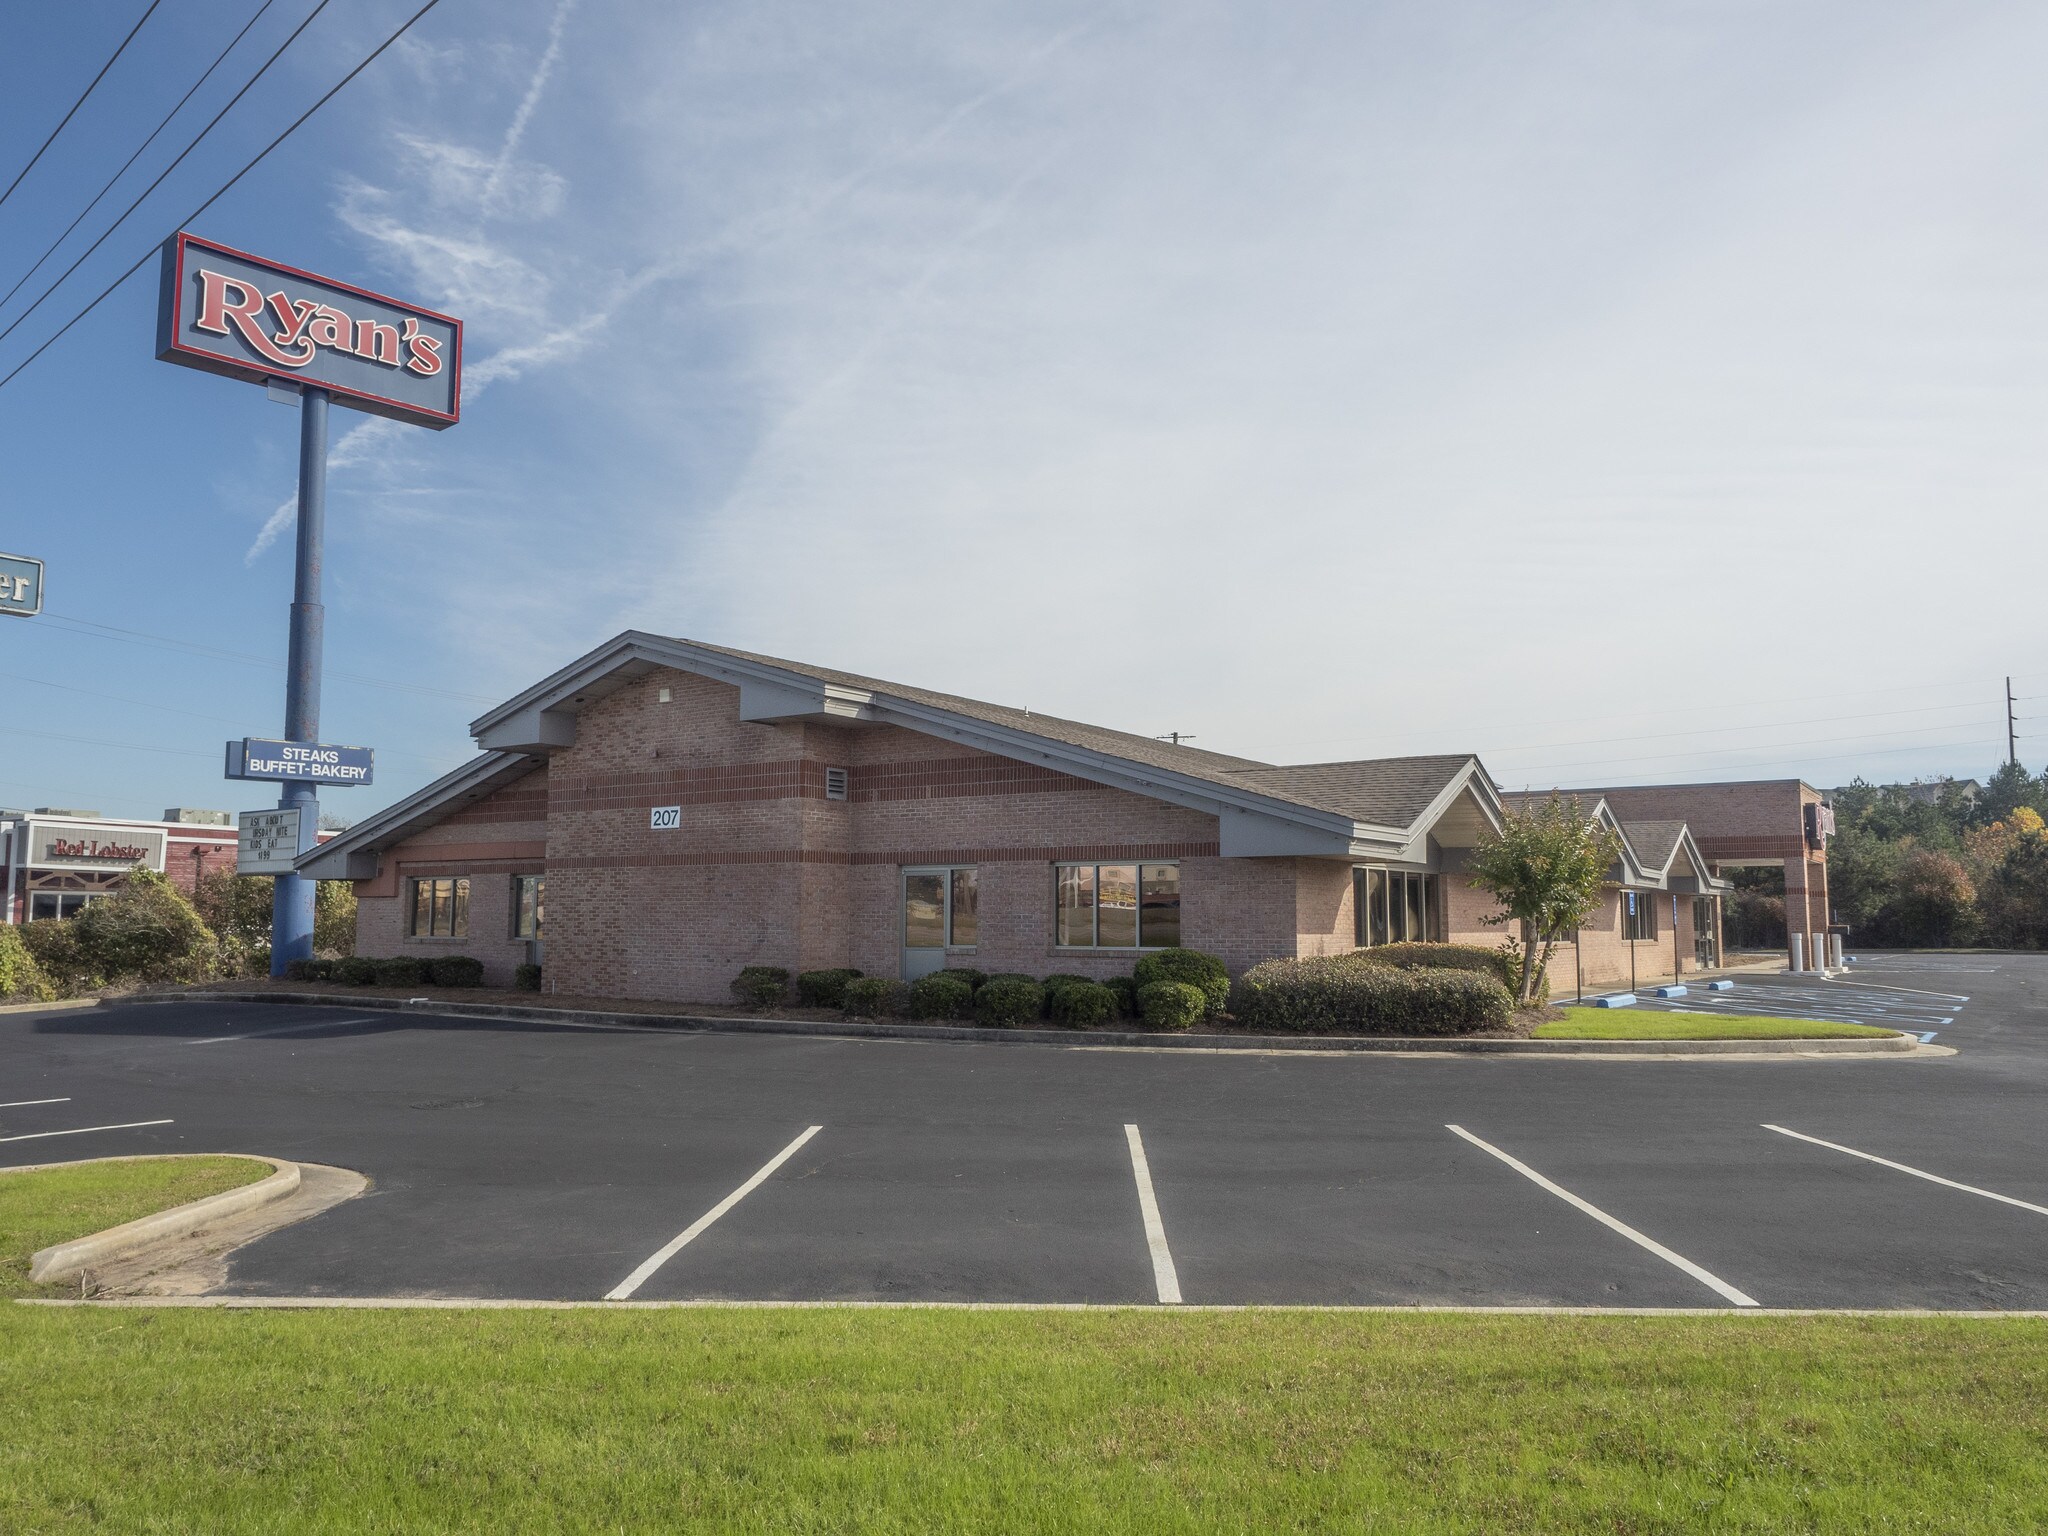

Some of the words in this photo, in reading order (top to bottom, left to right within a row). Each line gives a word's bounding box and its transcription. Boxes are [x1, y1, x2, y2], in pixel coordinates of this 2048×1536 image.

[196, 268, 443, 376] Ryan's
[282, 747, 339, 763] STEAKS
[249, 758, 368, 779] BUFFET-BAKERY
[250, 817, 260, 827] ASK
[266, 815, 284, 825] ABOUT
[653, 809, 679, 827] 207
[55, 838, 85, 857] Red
[89, 840, 149, 859] Lobster
[250, 839, 262, 849] KIDS
[267, 838, 278, 848] EAT
